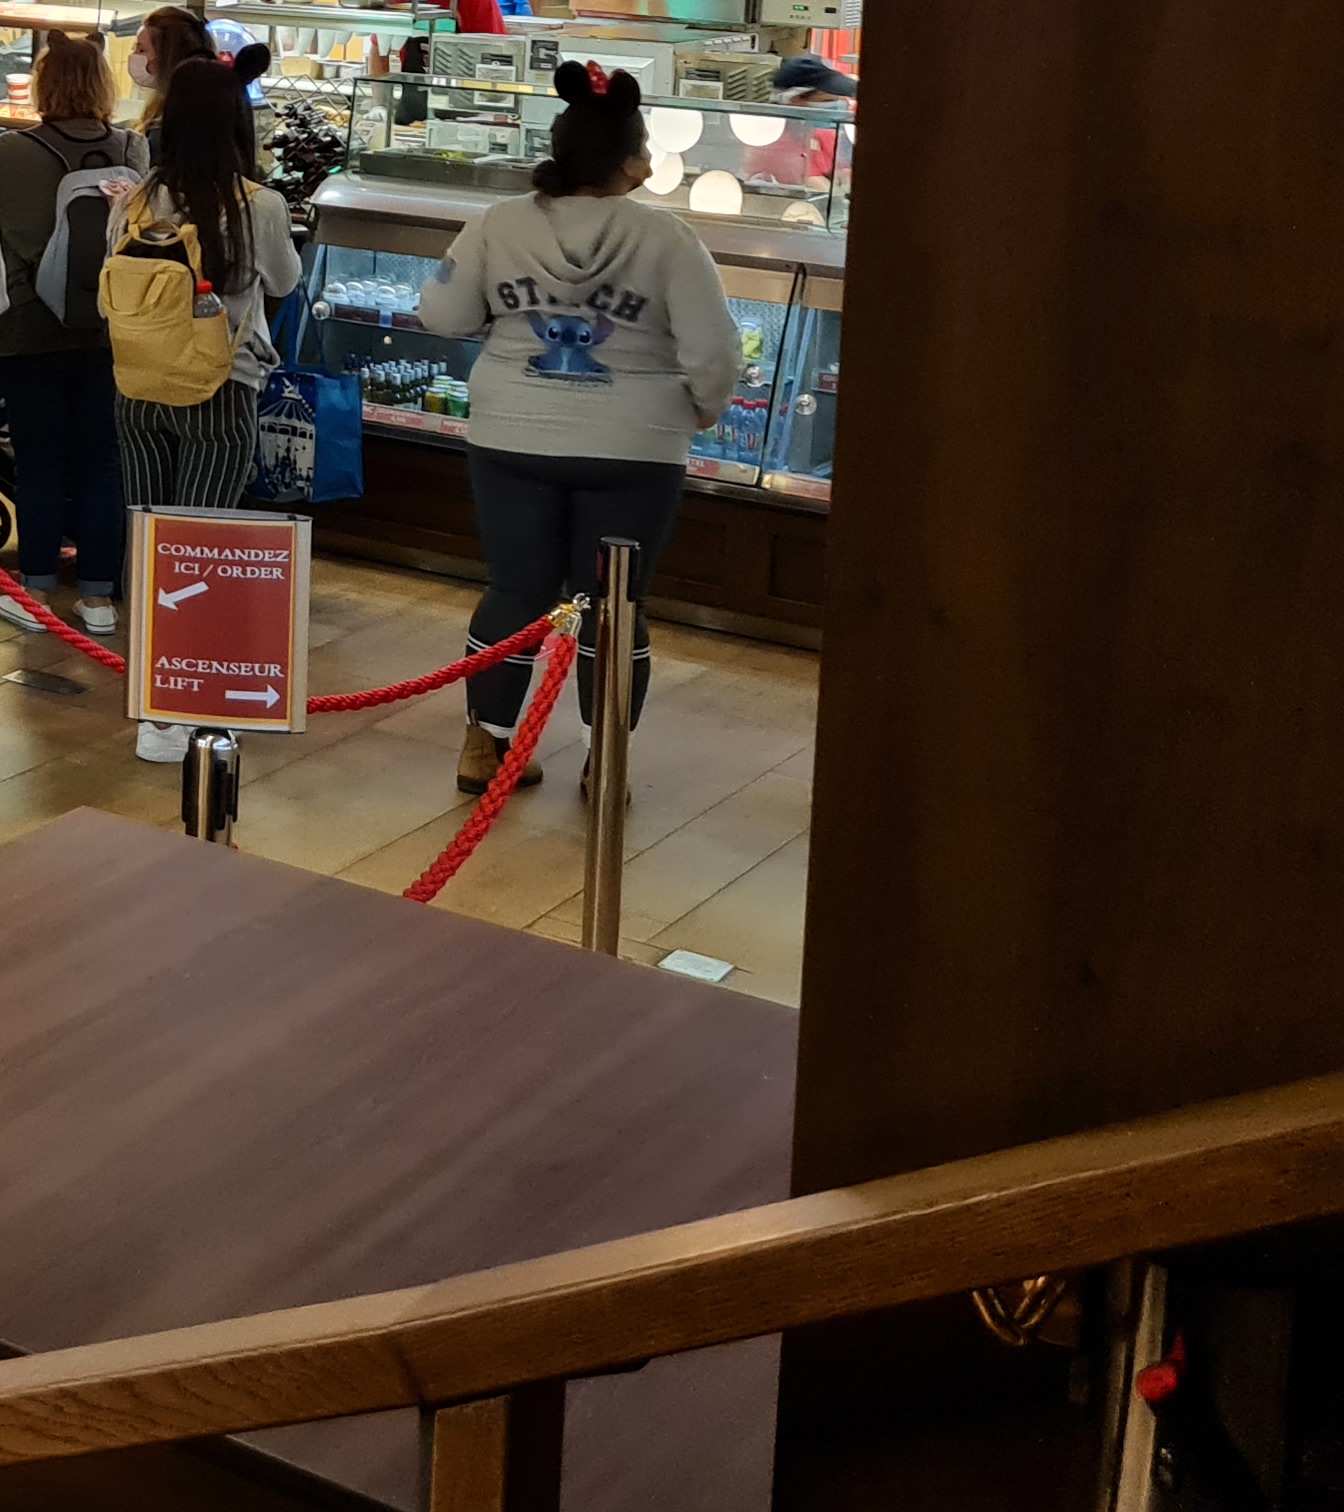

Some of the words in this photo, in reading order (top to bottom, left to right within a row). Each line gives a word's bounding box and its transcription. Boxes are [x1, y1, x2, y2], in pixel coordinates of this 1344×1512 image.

[497, 276, 649, 323] STCH
[157, 543, 290, 563] COMMANDEZ
[174, 561, 200, 576] ICI
[203, 564, 214, 578] /
[217, 565, 285, 580] ORDER
[155, 655, 285, 678] ASCENSEUR
[154, 675, 205, 692] LIFT
